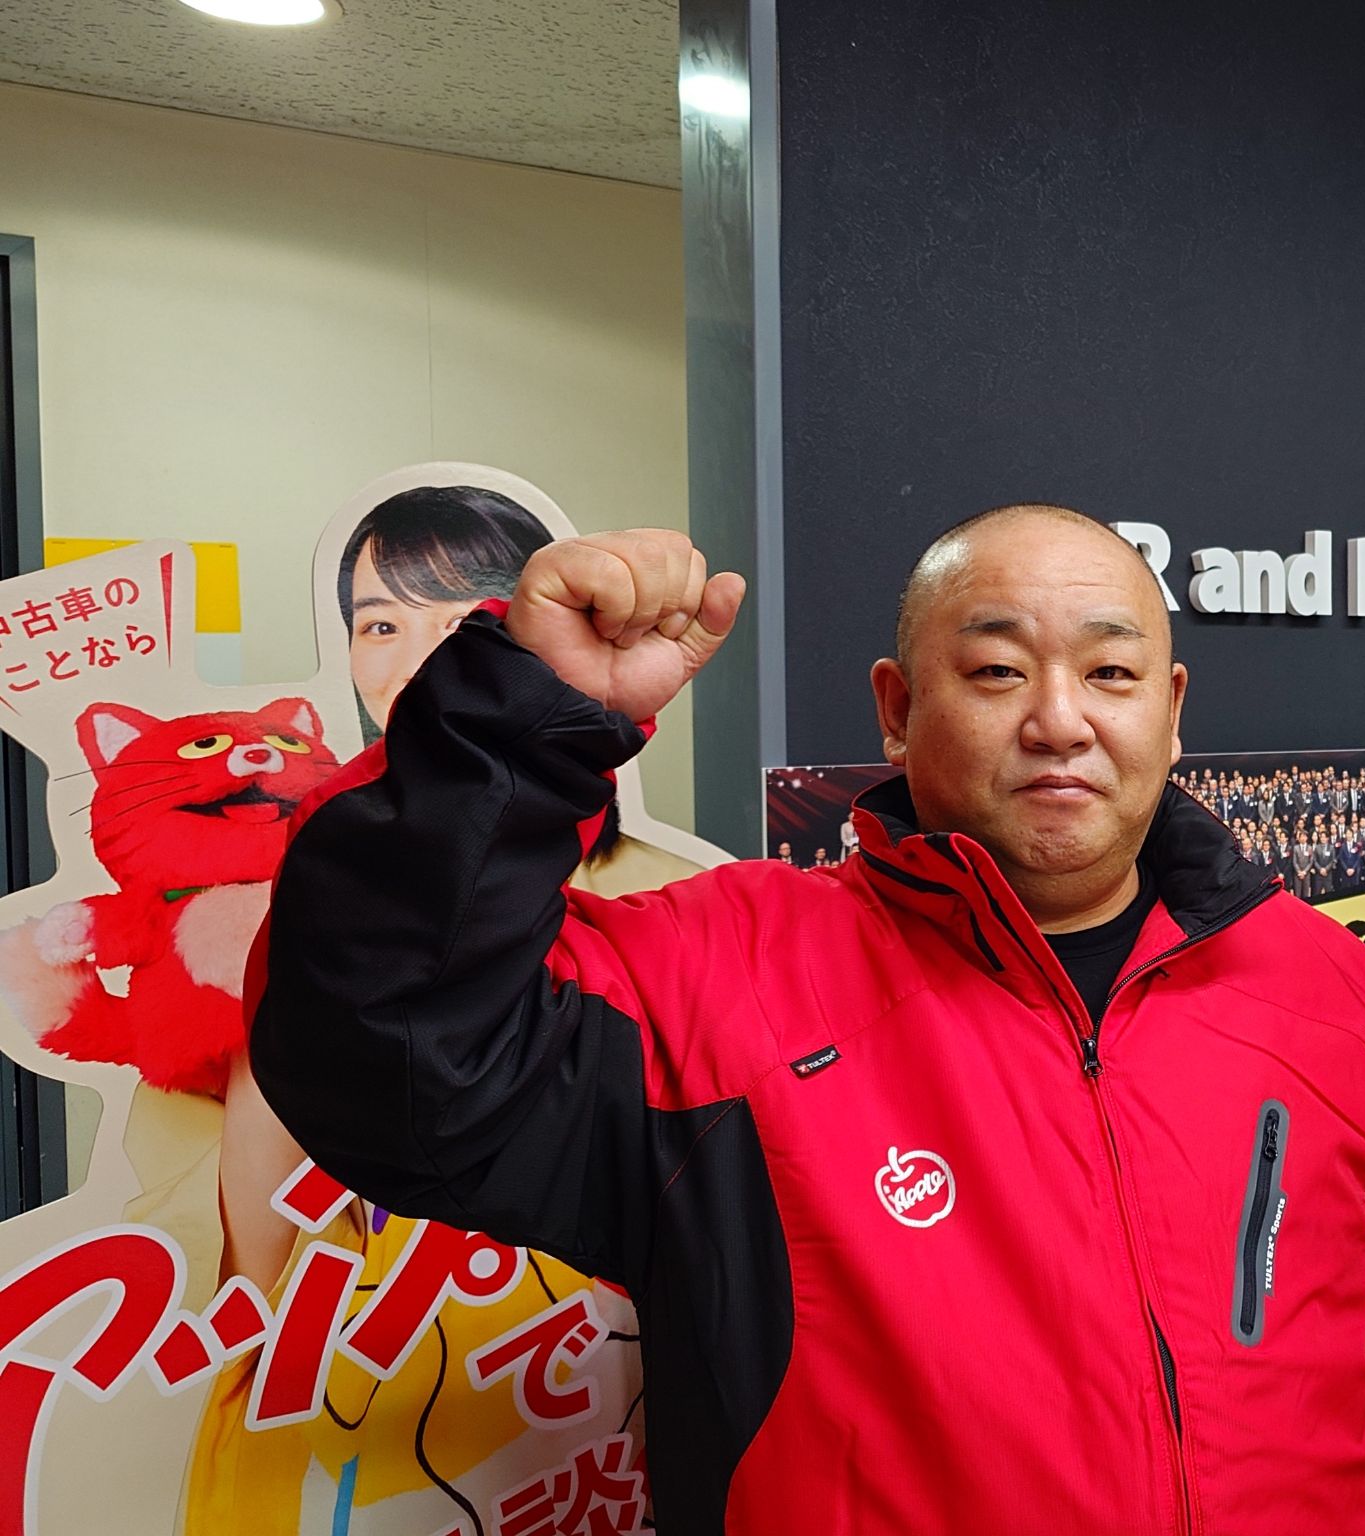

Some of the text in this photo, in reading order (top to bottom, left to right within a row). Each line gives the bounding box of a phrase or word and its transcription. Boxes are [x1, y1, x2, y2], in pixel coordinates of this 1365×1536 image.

[1189, 530, 1333, 617] and
[5, 625, 157, 692] ことなら
[1270, 1197, 1287, 1235] Sports
